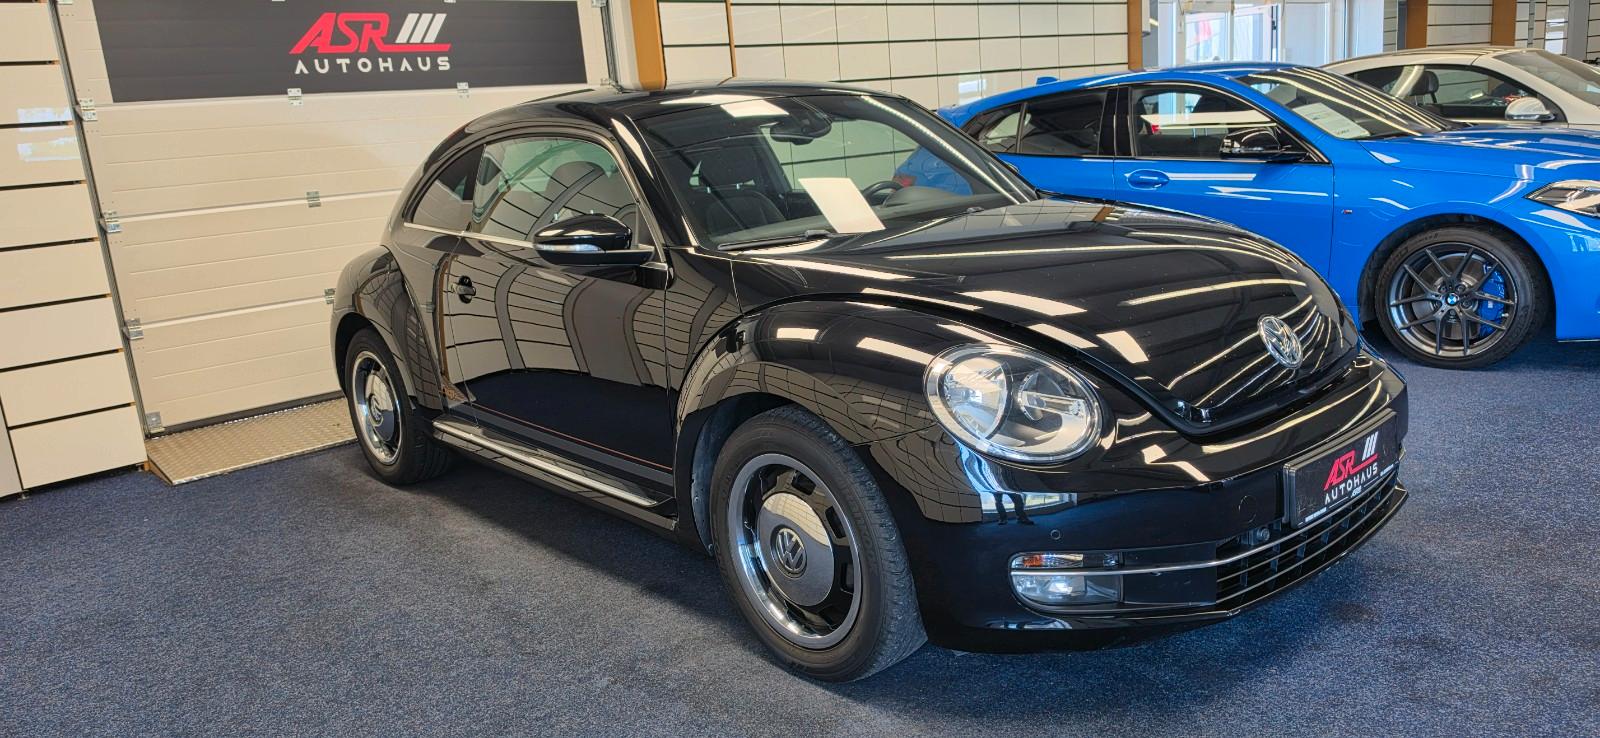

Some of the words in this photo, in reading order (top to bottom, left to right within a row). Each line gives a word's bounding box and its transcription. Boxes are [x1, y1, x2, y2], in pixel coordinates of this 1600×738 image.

[289, 12, 451, 54] ASR
[294, 56, 451, 74] AUTOHAUS
[1323, 449, 1379, 491] ASR
[1324, 462, 1378, 505] AUTOHAUS
